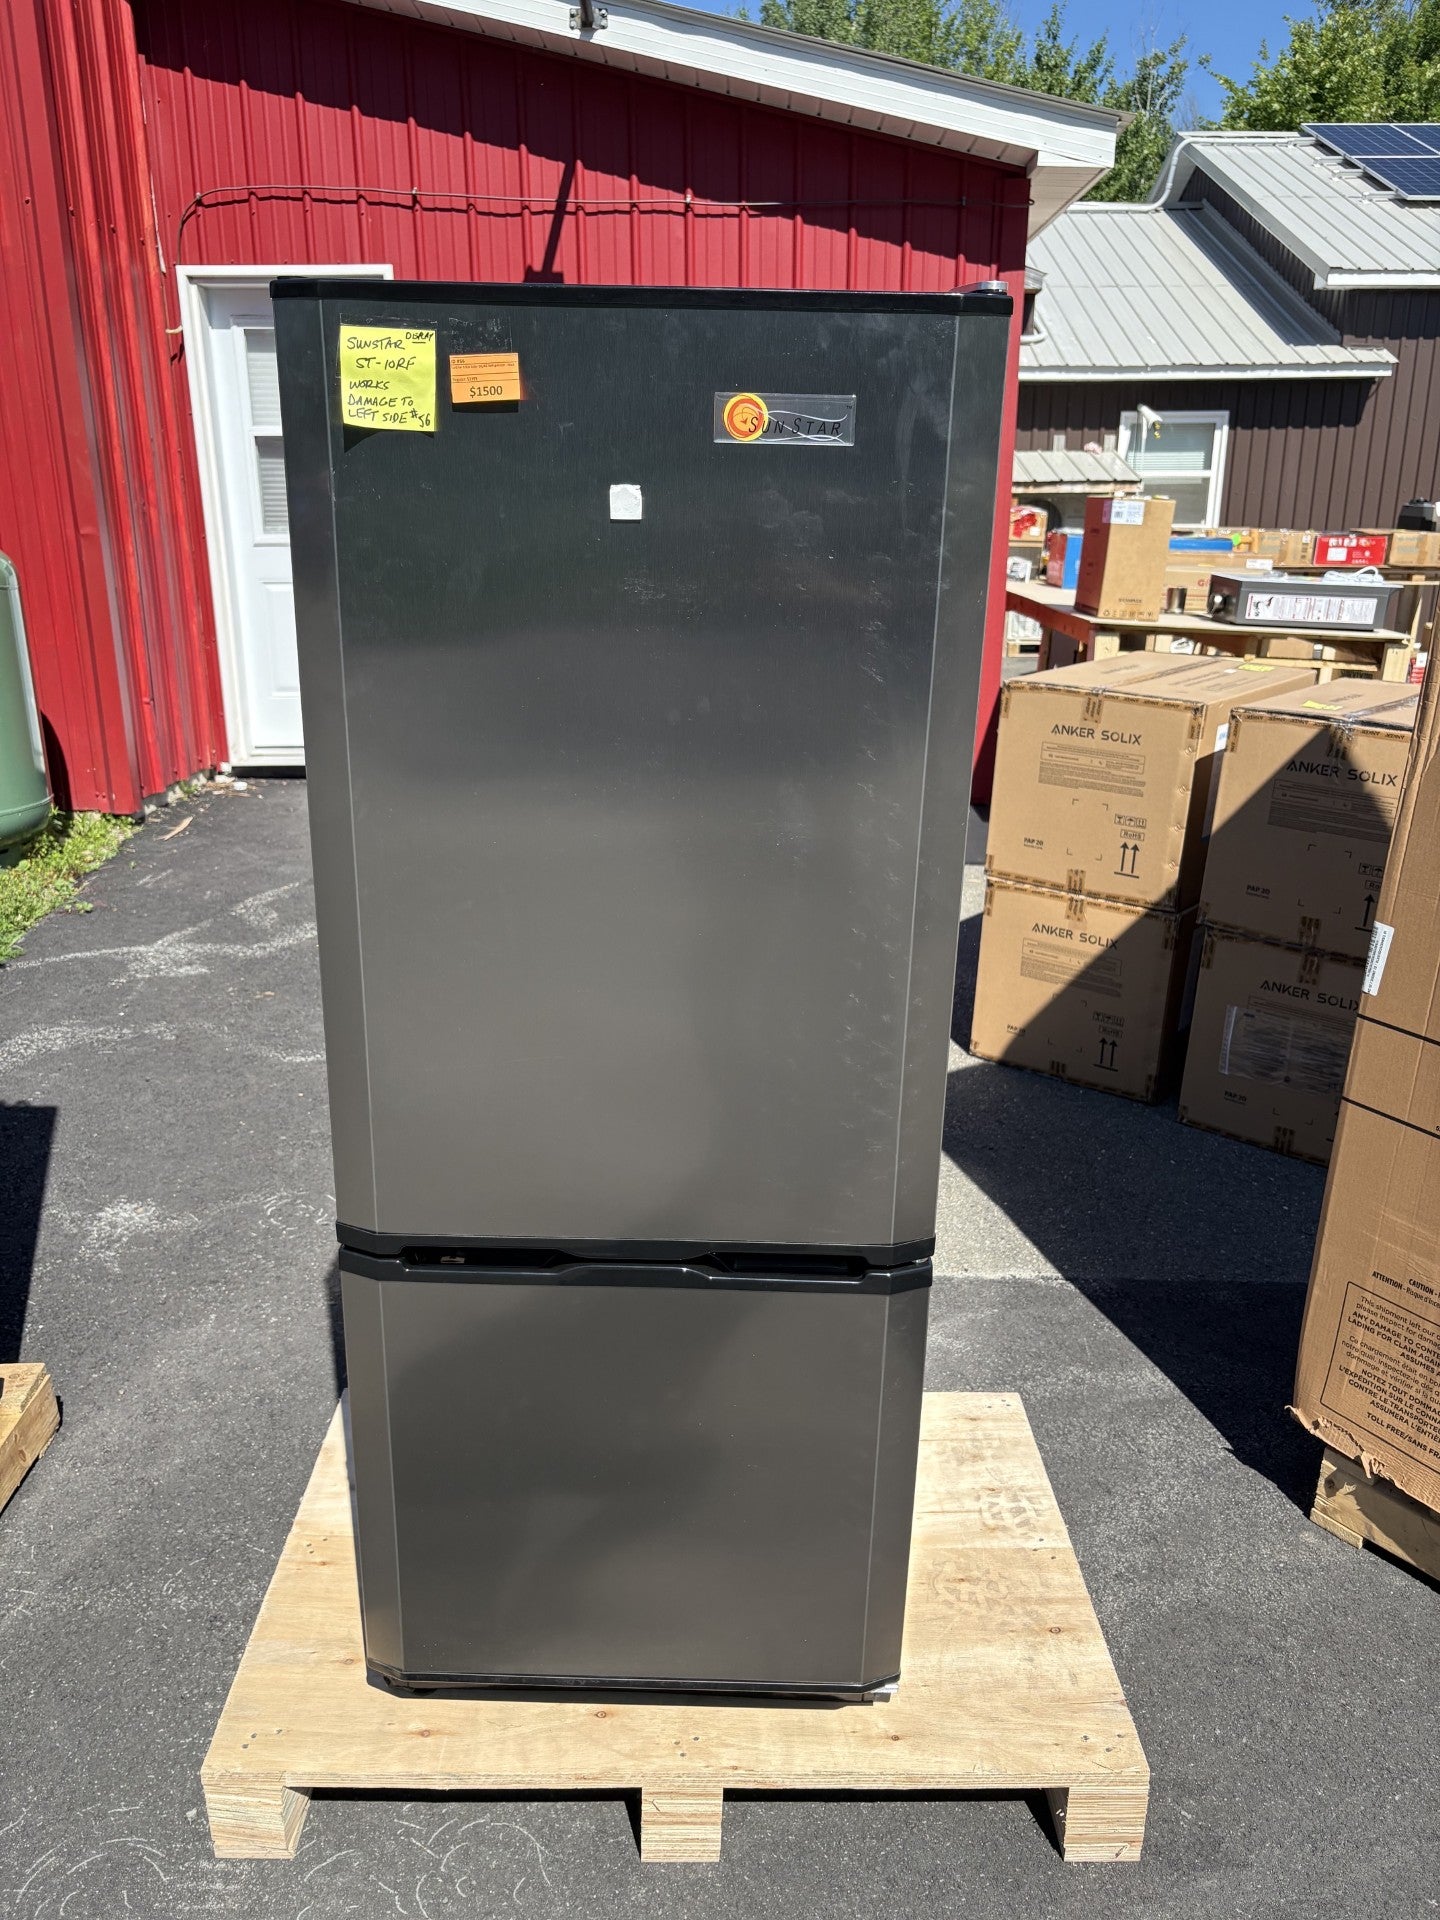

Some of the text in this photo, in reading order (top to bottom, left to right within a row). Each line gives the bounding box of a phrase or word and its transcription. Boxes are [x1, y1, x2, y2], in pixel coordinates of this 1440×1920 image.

[346, 337, 406, 350] SUNSTAR
[355, 356, 417, 370] ST-10RF
[349, 380, 391, 391] WORKS
[469, 385, 503, 398] $1500
[347, 393, 414, 407] DAMAGE TO
[348, 407, 379, 422] LEFT
[382, 411, 409, 424] SIDE
[792, 417, 842, 435] STAR
[1050, 723, 1143, 746] ANKER SOLIX
[1286, 759, 1399, 787] ANKER SOLIX
[1031, 921, 1119, 950] ANKER SOLIX
[1259, 979, 1311, 1001] ANKER
[1371, 1270, 1403, 1290] ATTENTION
[1406, 1286, 1424, 1301] Risque
[1408, 1278, 1434, 1296] CAUTION
[1352, 1310, 1369, 1322] ANY
[1369, 1318, 1402, 1339] DAMAGE
[1403, 1334, 1415, 1346] TO
[1356, 1302, 1379, 1318] please
[1379, 1314, 1404, 1330] inspect
[1405, 1326, 1417, 1339] for
[1360, 1295, 1375, 1308] This
[1375, 1304, 1408, 1324] shipment
[1408, 1319, 1421, 1331] left
[1422, 1326, 1436, 1338] our
[1341, 1340, 1360, 1354] notre
[1347, 1315, 1376, 1335] LADING
[1376, 1331, 1393, 1344] FOR
[1393, 1339, 1418, 1356] CLAIM
[1346, 1350, 1380, 1375] dommage
[1380, 1368, 1389, 1379] et
[1414, 1386, 1422, 1395] si
[1359, 1341, 1401, 1366] chargement
[1418, 1371, 1428, 1381] en
[1400, 1351, 1435, 1374] ASSUMES
[1348, 1379, 1379, 1400] CONTRE
[1379, 1395, 1389, 1407] LE
[1361, 1368, 1387, 1387] NOTEZ
[1387, 1382, 1408, 1399] TOUT
[1369, 1399, 1409, 1427] ASSUMERA
[1388, 1391, 1404, 1406] SUR
[1404, 1400, 1415, 1412] LE
[1366, 1411, 1385, 1427] TOLL
[1385, 1423, 1428, 1452] FREE/SANS
